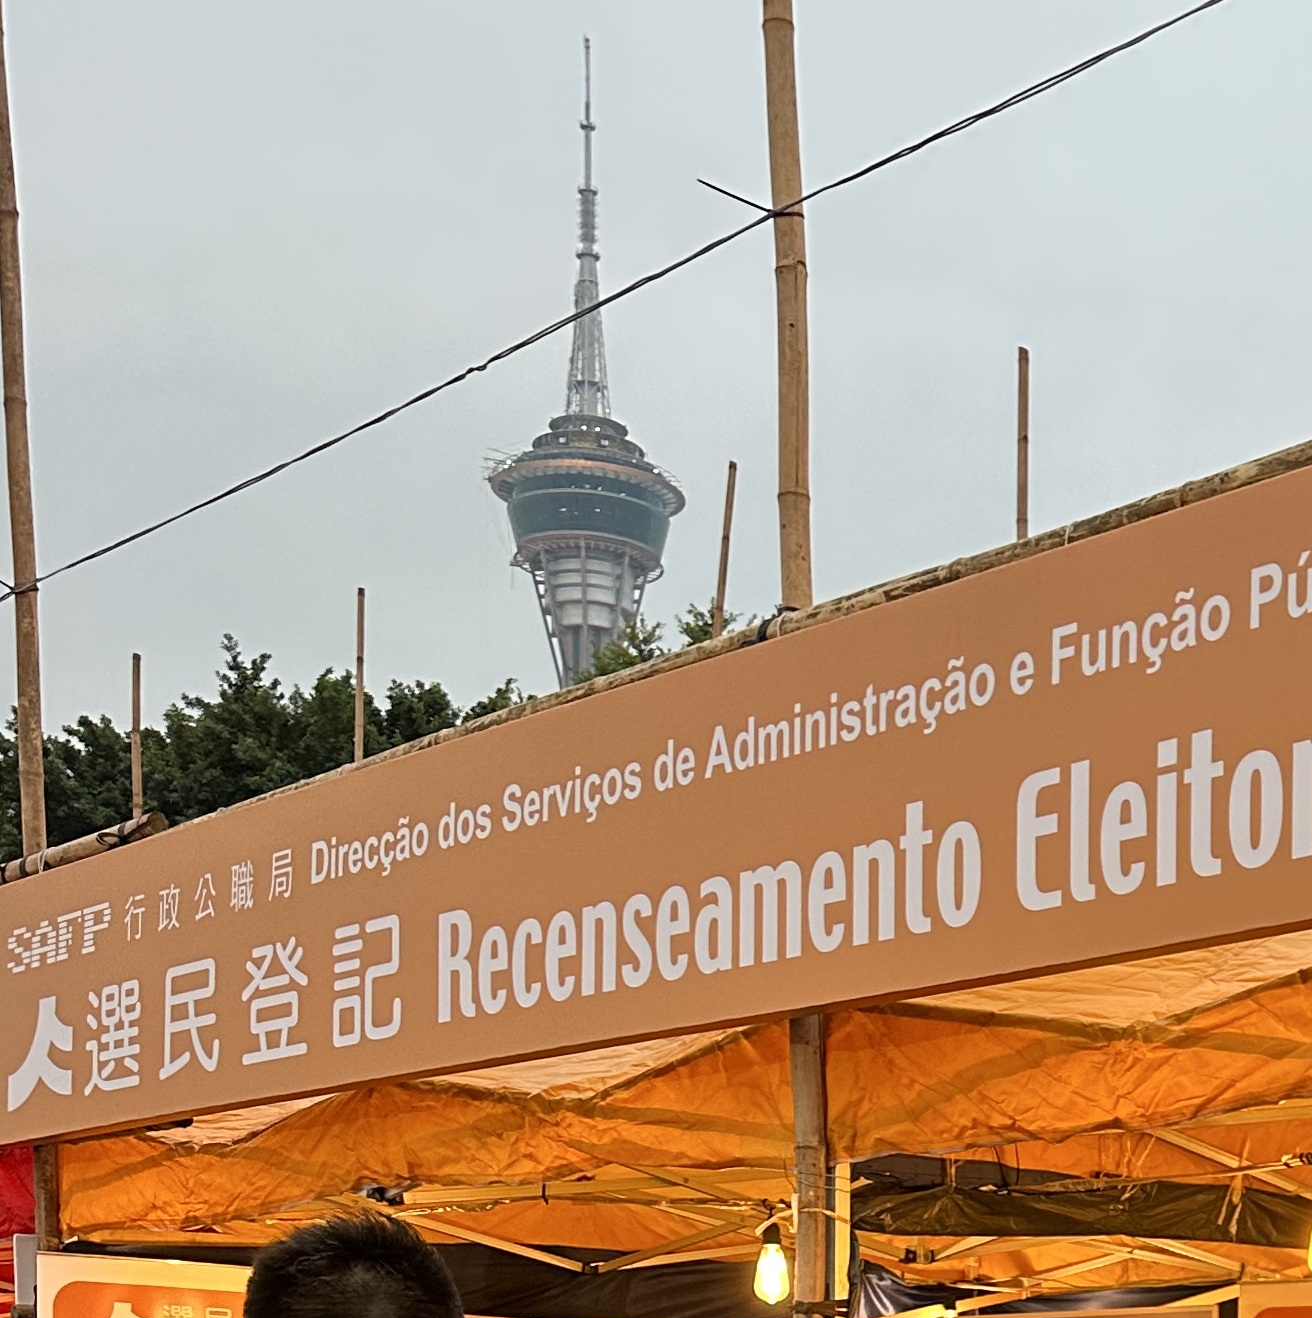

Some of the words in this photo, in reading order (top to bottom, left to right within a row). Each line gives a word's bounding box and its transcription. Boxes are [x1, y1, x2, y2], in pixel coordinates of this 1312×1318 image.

[311, 816, 428, 884] Direcção
[438, 804, 492, 848] dos
[502, 764, 642, 829] Serviços
[653, 740, 695, 792] de
[705, 656, 995, 779] Administração
[1010, 651, 1034, 695] e
[1051, 588, 1231, 685] Função
[124, 848, 294, 942] 行政公職局
[437, 801, 981, 1024] Recenseamento
[84, 914, 402, 1097] 選民登記
